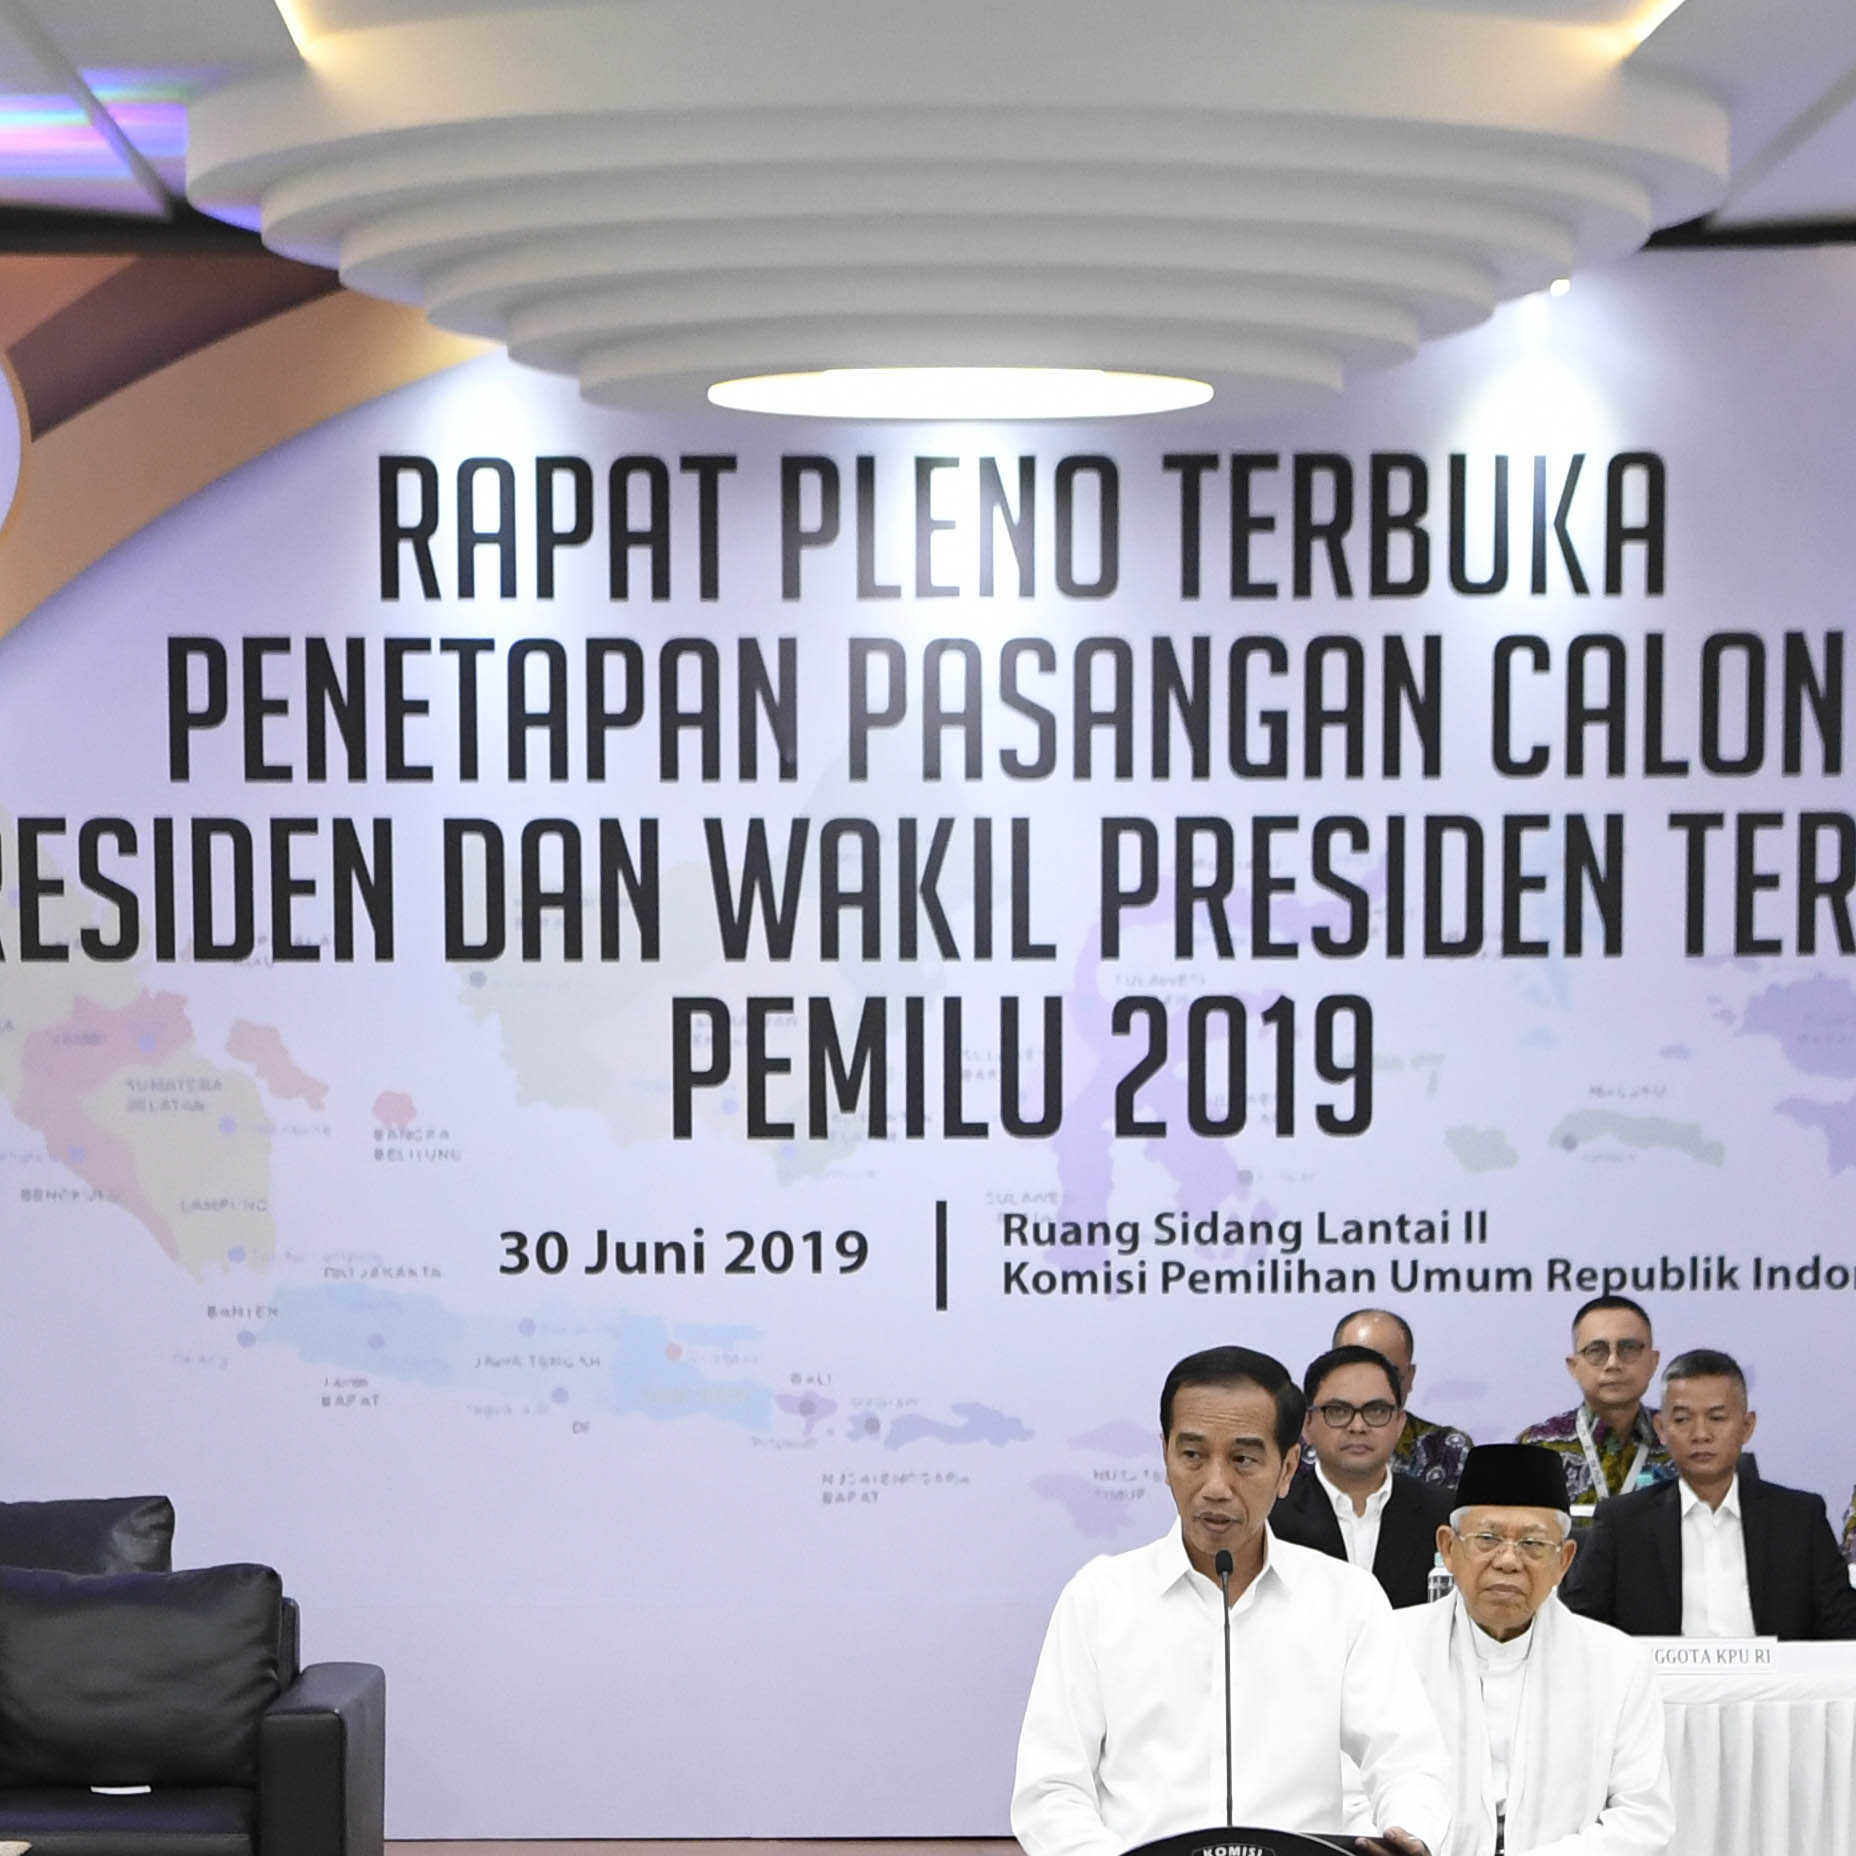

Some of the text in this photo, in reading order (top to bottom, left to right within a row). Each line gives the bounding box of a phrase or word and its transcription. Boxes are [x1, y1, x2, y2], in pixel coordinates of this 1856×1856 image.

[379, 451, 1666, 601] RAPAT PLENO TERBUKA
[168, 630, 1845, 783] PENETAPAN PASANGAN CALON
[444, 818, 660, 962] DAN
[704, 817, 1057, 961] WAKIL
[1101, 814, 1624, 959] PRESIDEN
[673, 994, 1373, 1139] PEMILU 2019
[499, 1227, 868, 1275] 30 Juni 2019
[1003, 1209, 1487, 1256] Ruang Sidang Lantai II
[1003, 1260, 1146, 1294] Komisi
[1161, 1258, 1376, 1294] Pemilihan
[1390, 1259, 1533, 1293] Umum
[1547, 1256, 1740, 1295] Republik
[1653, 1647, 1771, 1665] GGOTA KPU RI
